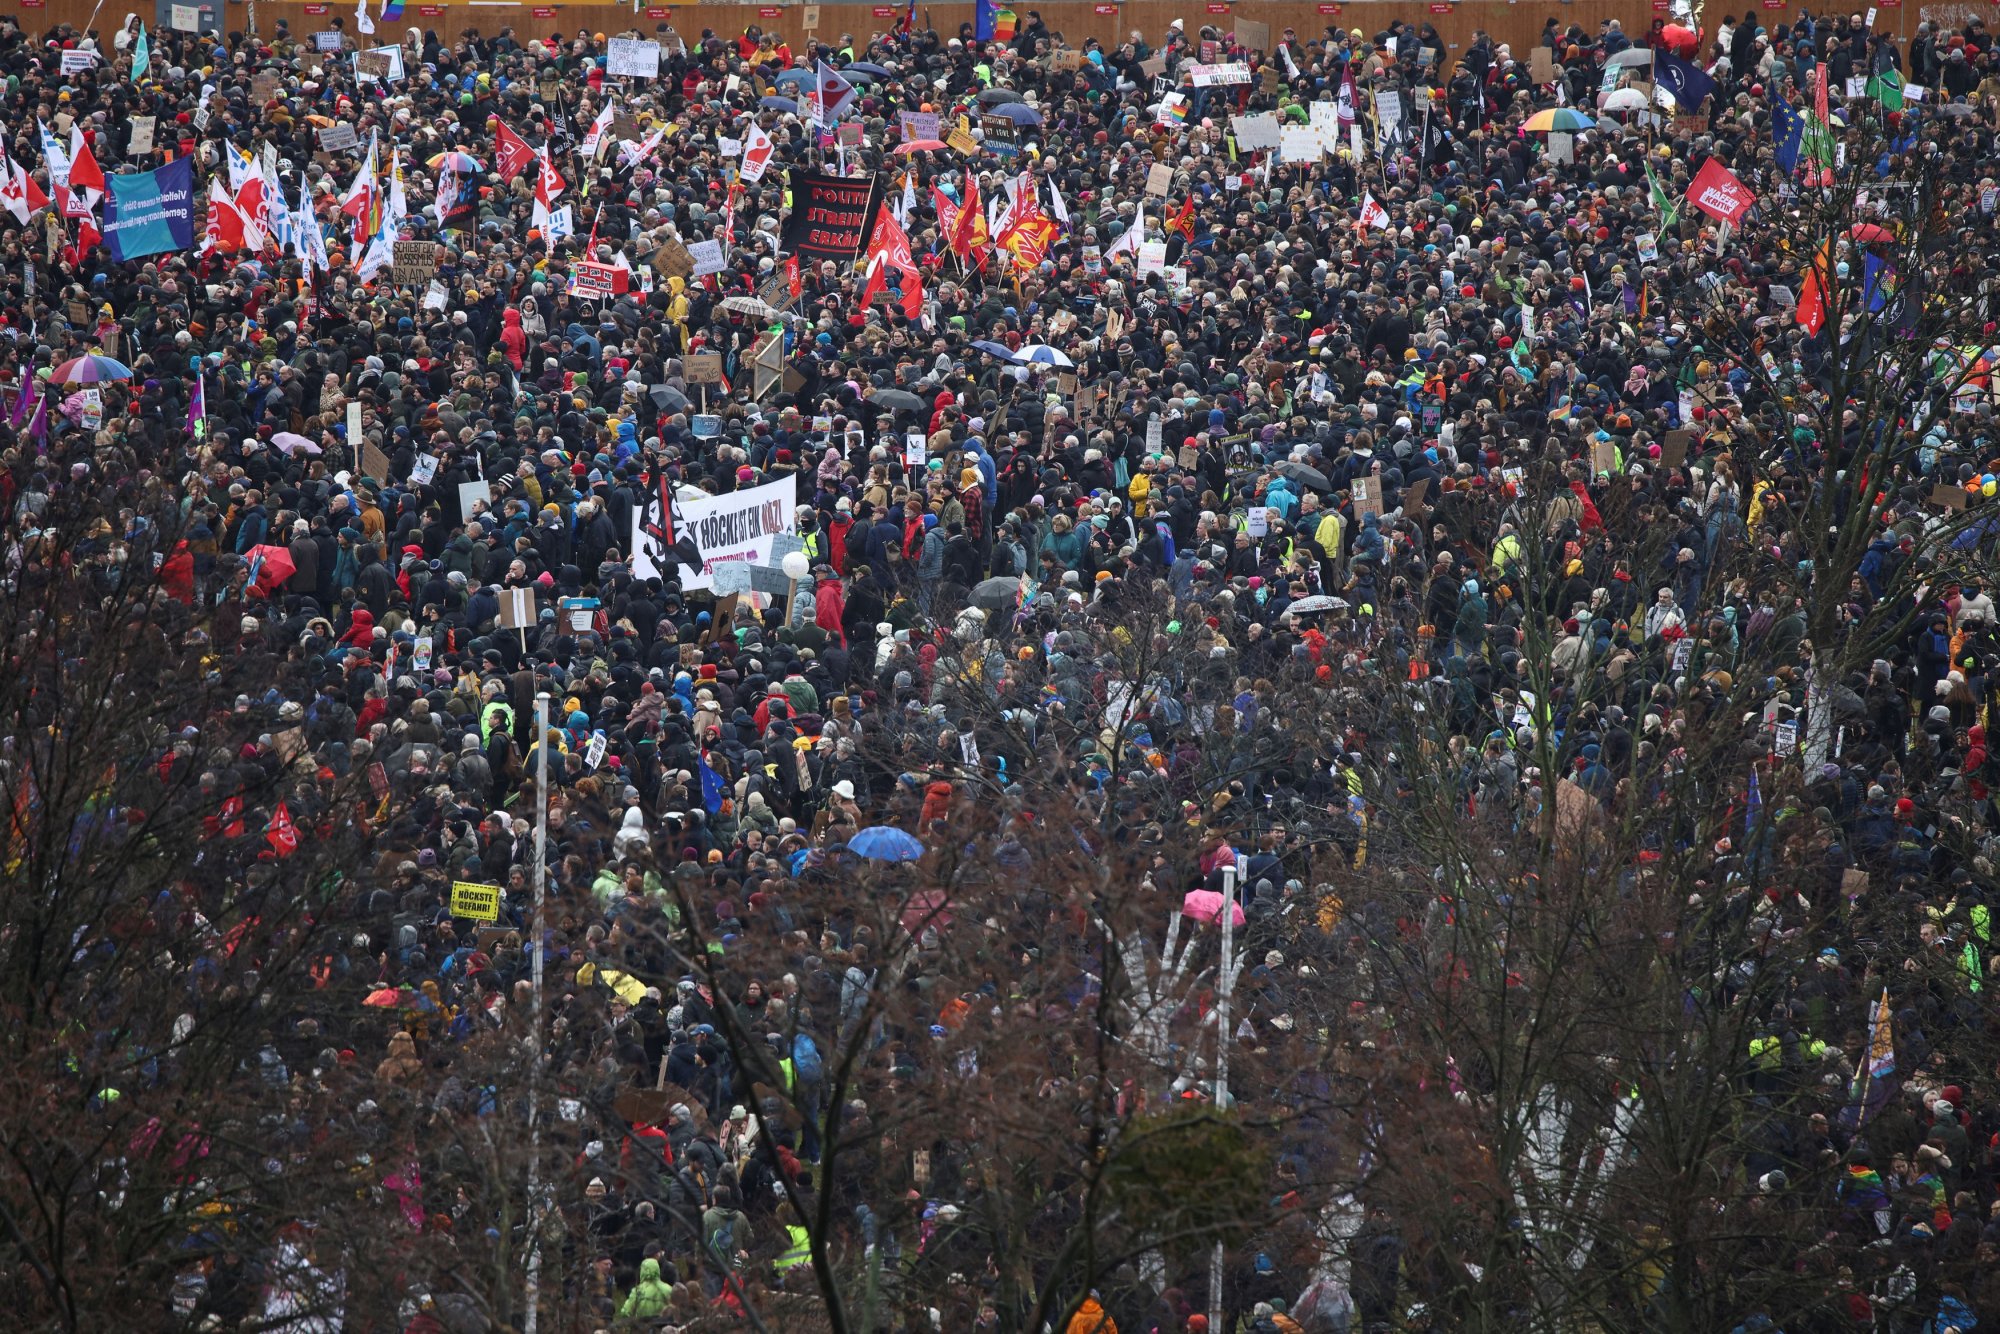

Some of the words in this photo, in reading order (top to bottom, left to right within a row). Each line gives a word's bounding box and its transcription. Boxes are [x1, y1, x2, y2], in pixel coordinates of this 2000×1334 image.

[612, 47, 639, 55] MYANMAR
[608, 60, 619, 68] DIE
[623, 62, 657, 71] VORBILDER
[905, 117, 935, 126] FEMINISMUS
[1706, 186, 1739, 207] WAFFEN
[1704, 195, 1732, 213] KRITIK
[394, 242, 420, 252] SCHIEBT
[393, 254, 434, 266] RASSISMUS
[394, 268, 406, 276] IN
[393, 275, 407, 283] DEN
[579, 277, 595, 286] BRAND
[761, 499, 784, 536] NAZI
[700, 509, 738, 551] HÖCKE
[738, 510, 747, 543] IST
[747, 505, 762, 539] EIN
[458, 889, 493, 902] HÖCKSTE
[458, 901, 490, 912] GEFAHR!
